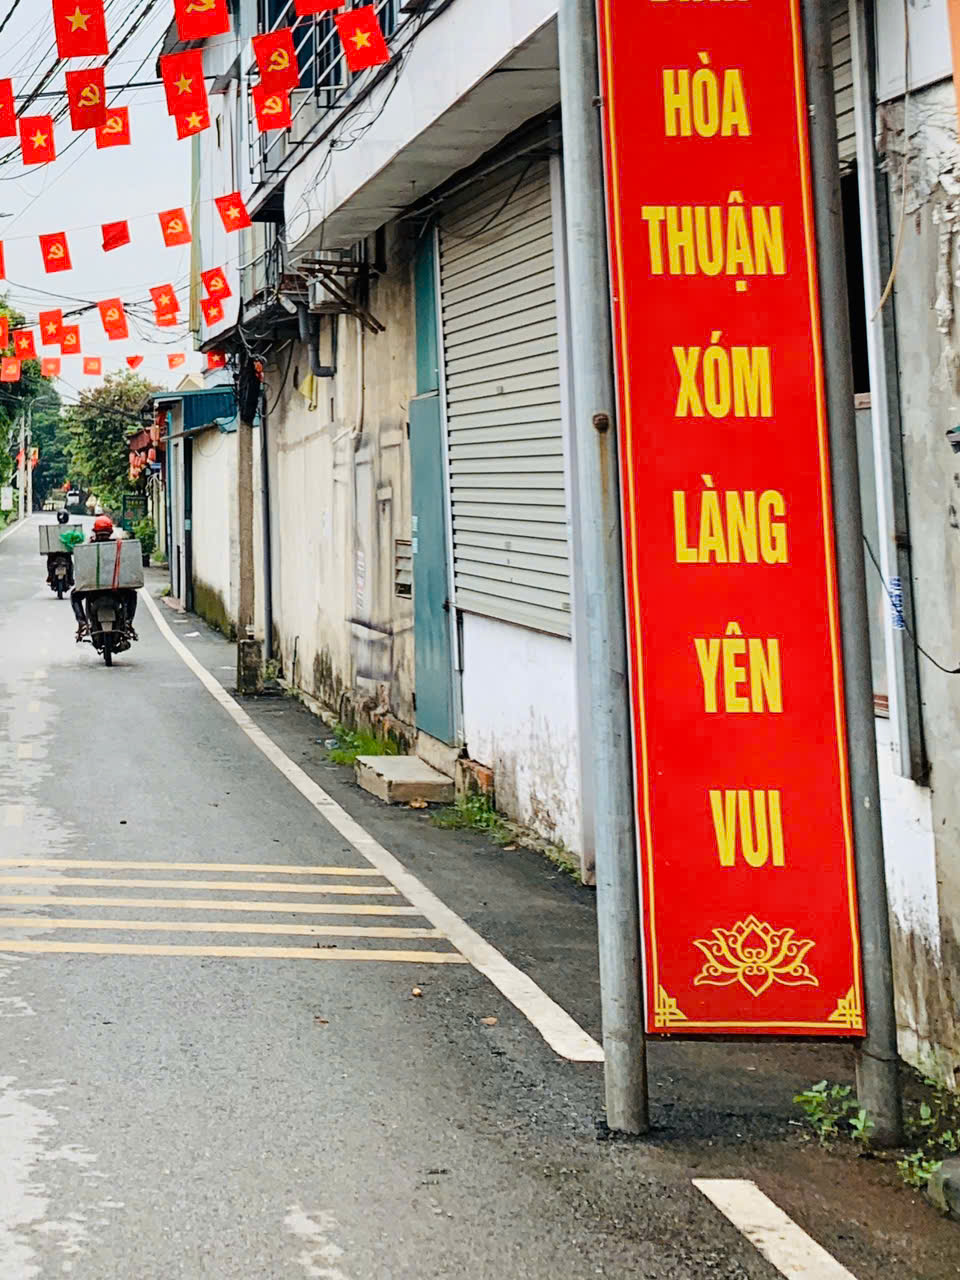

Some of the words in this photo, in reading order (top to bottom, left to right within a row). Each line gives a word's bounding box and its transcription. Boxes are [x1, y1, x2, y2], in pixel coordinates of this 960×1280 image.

[662, 52, 751, 137] HÒA
[641, 191, 786, 291] THUẬN
[673, 330, 772, 418] XÓM
[673, 474, 788, 564] LÀNG
[694, 622, 782, 713] YÊN
[710, 790, 785, 867] VUI
